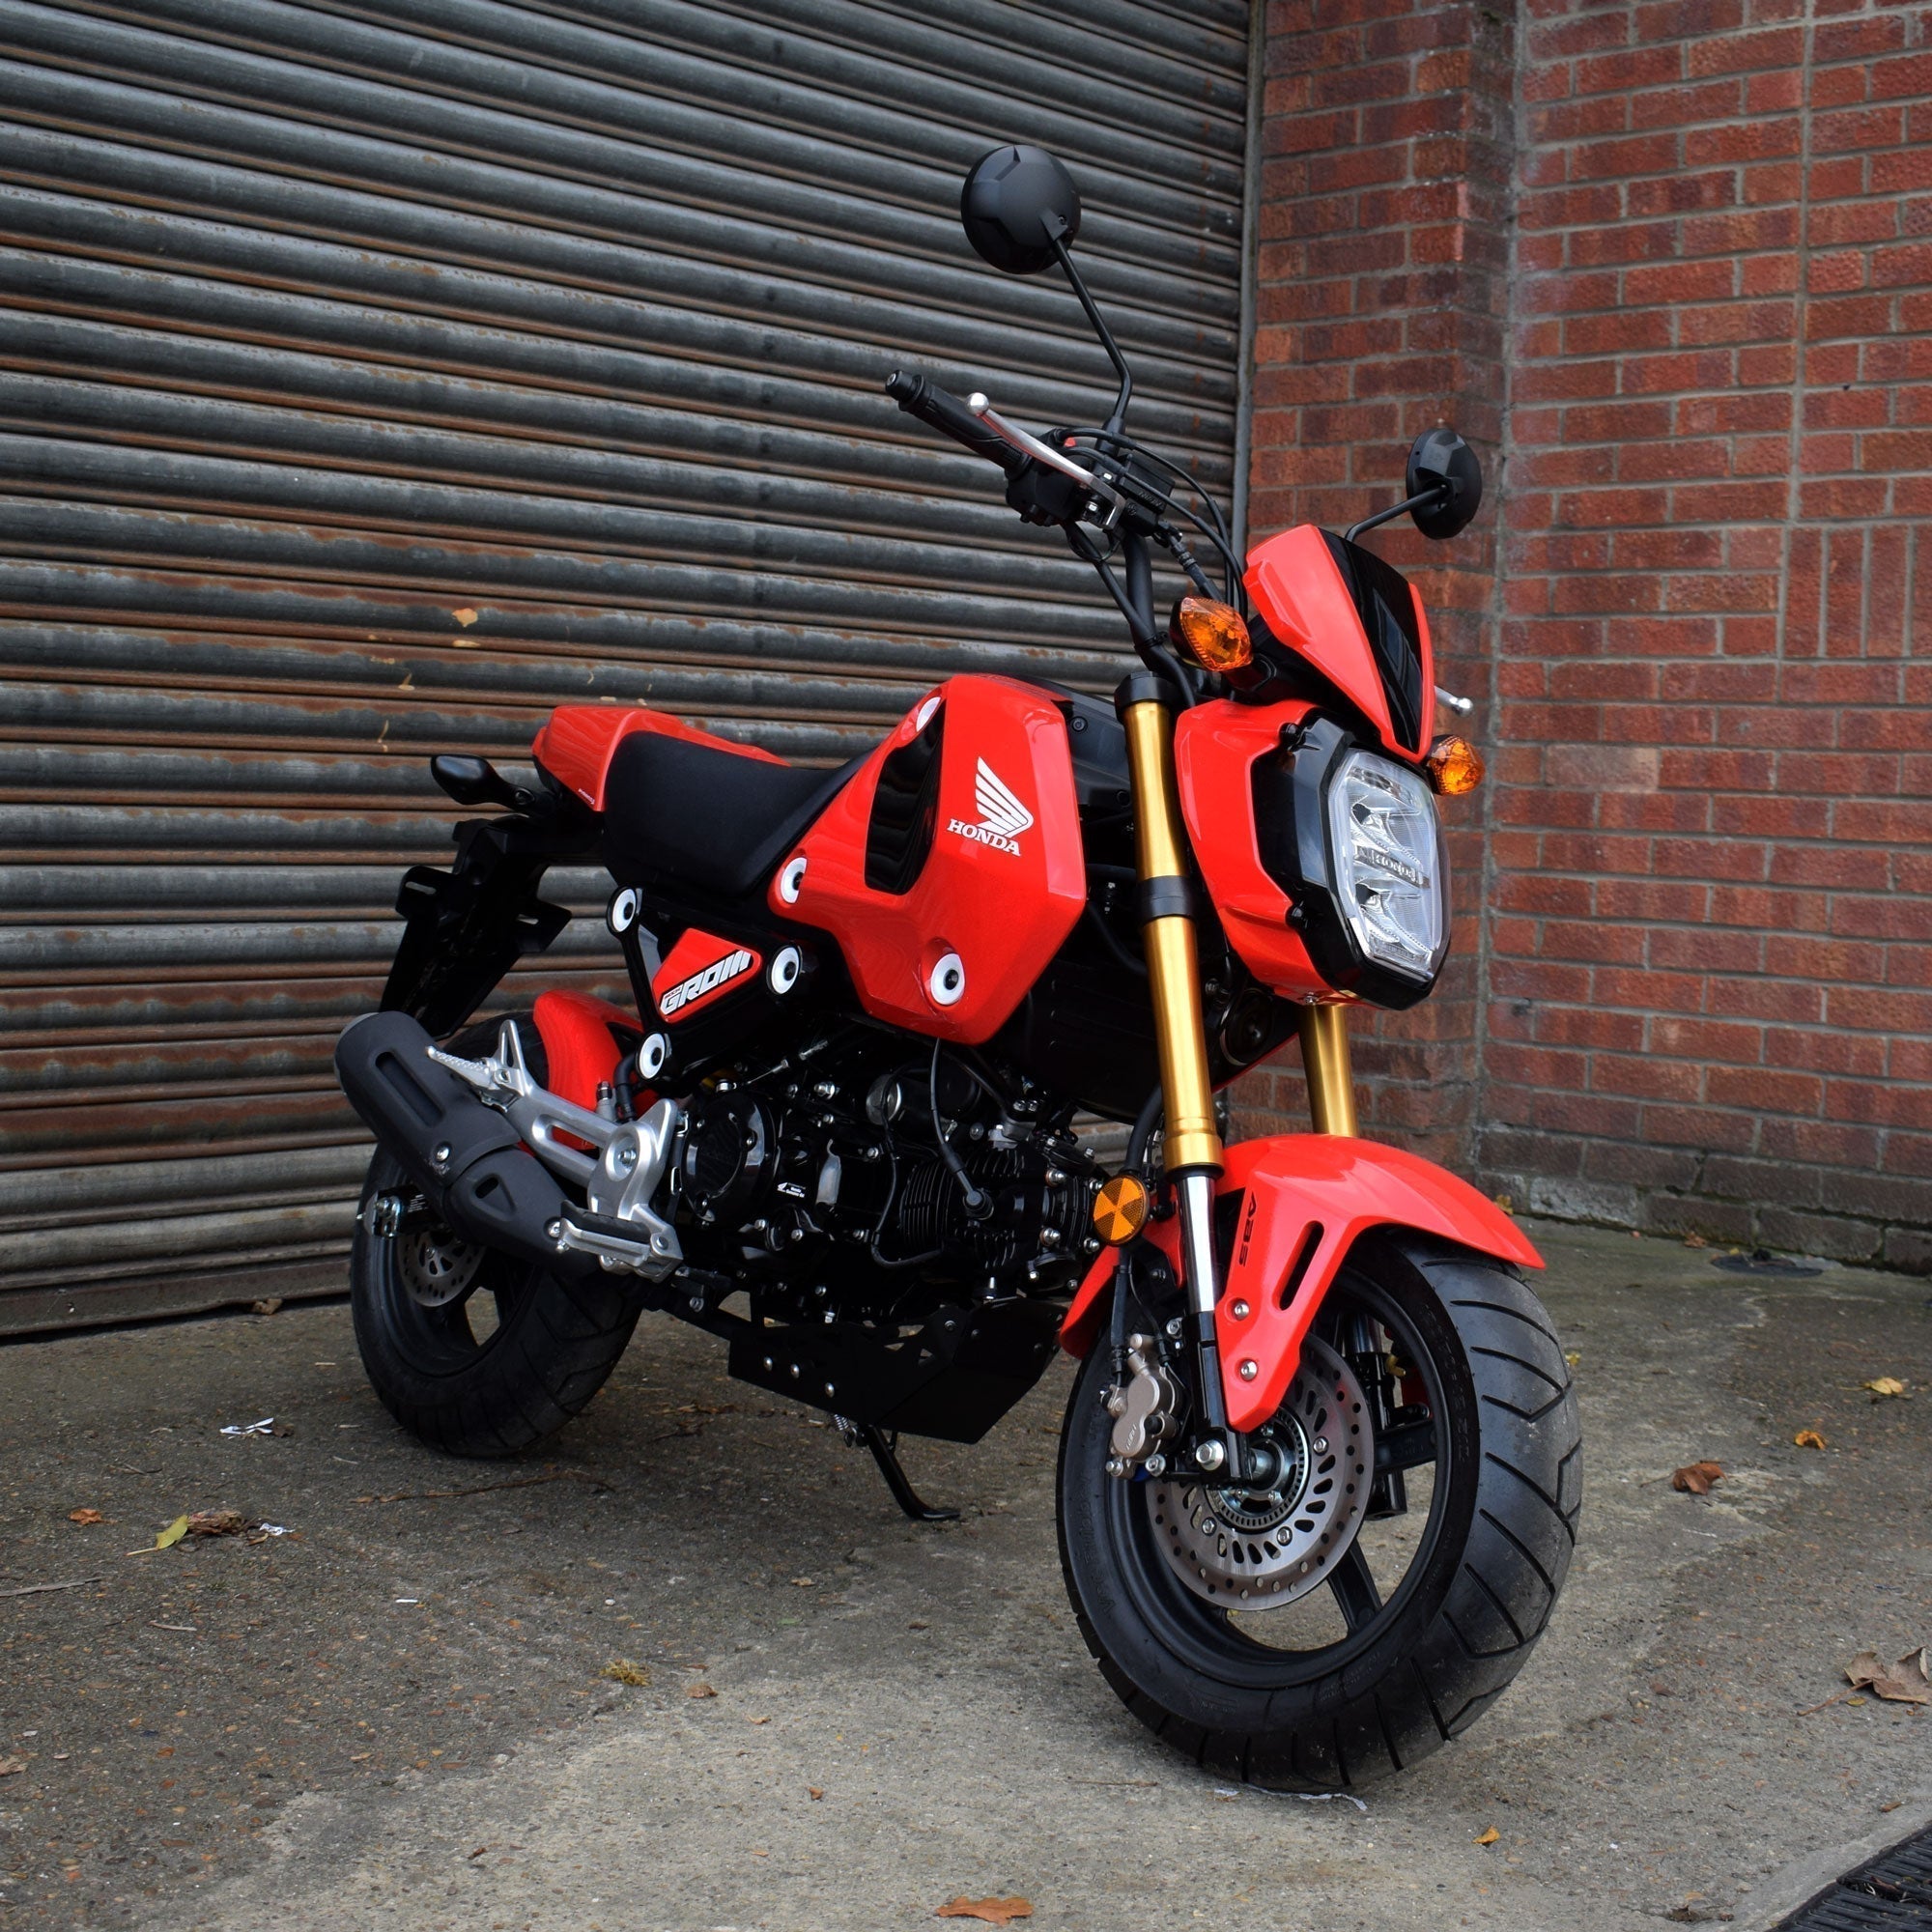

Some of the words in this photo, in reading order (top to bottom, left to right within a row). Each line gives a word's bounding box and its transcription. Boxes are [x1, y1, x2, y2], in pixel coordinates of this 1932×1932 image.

[947, 818, 1021, 857] HONDA
[660, 950, 752, 1015] GROM
[1238, 1190, 1257, 1267] ABS
